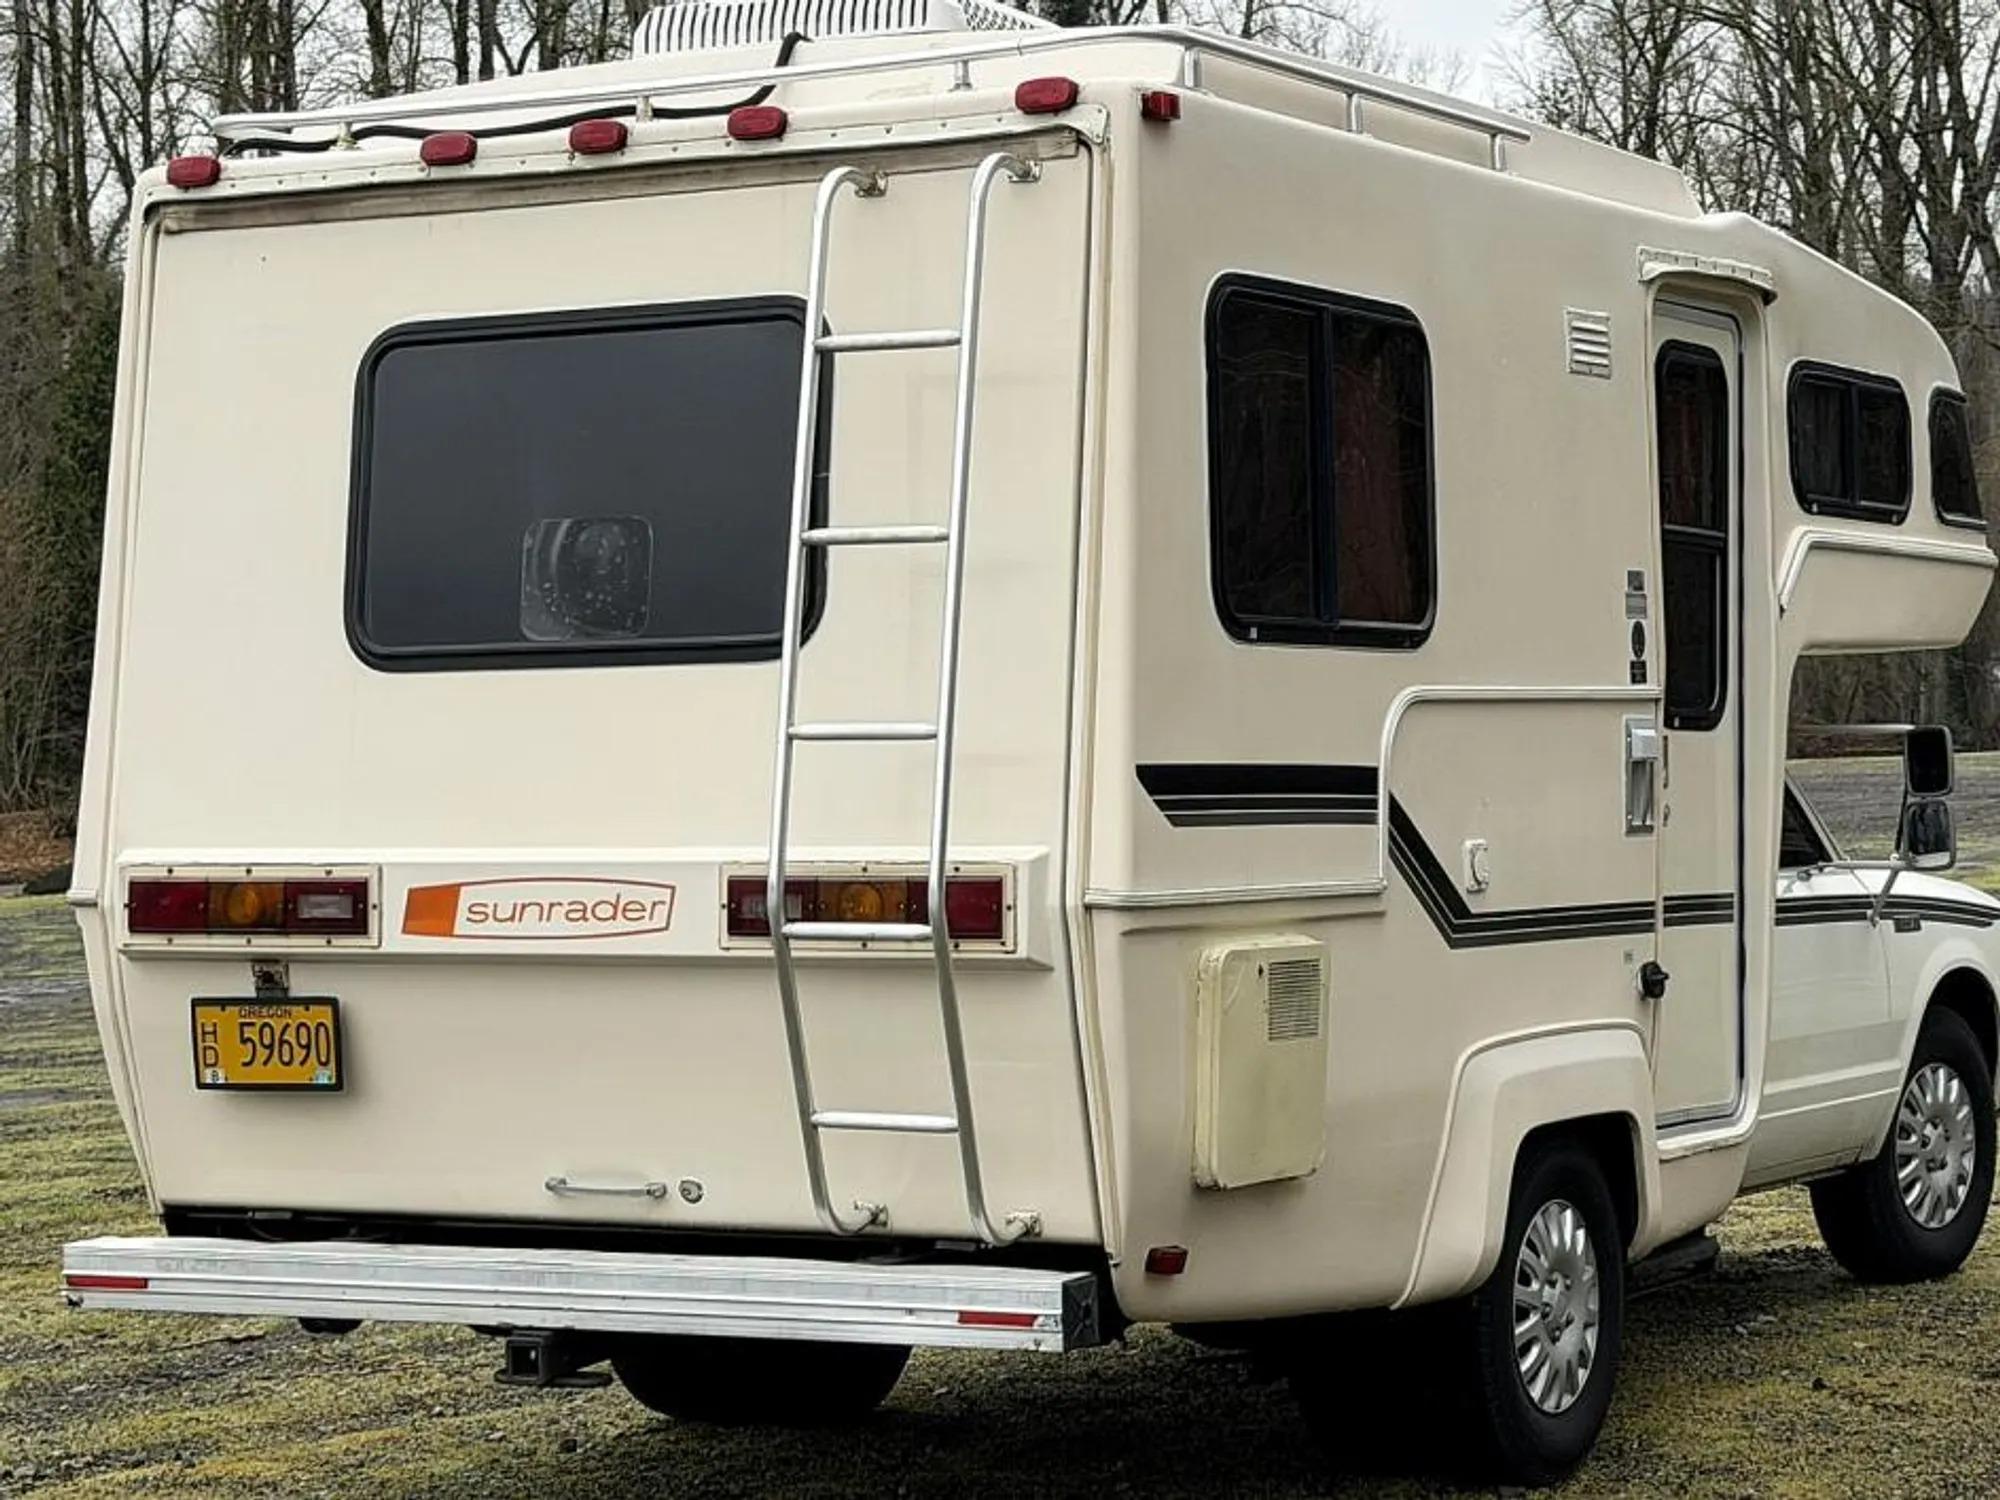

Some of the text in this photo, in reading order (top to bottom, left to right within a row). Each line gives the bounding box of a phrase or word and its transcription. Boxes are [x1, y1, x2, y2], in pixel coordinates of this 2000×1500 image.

[466, 893, 666, 923] sunrader
[239, 1006, 292, 1018] OREGON
[238, 1021, 331, 1067] 59690
